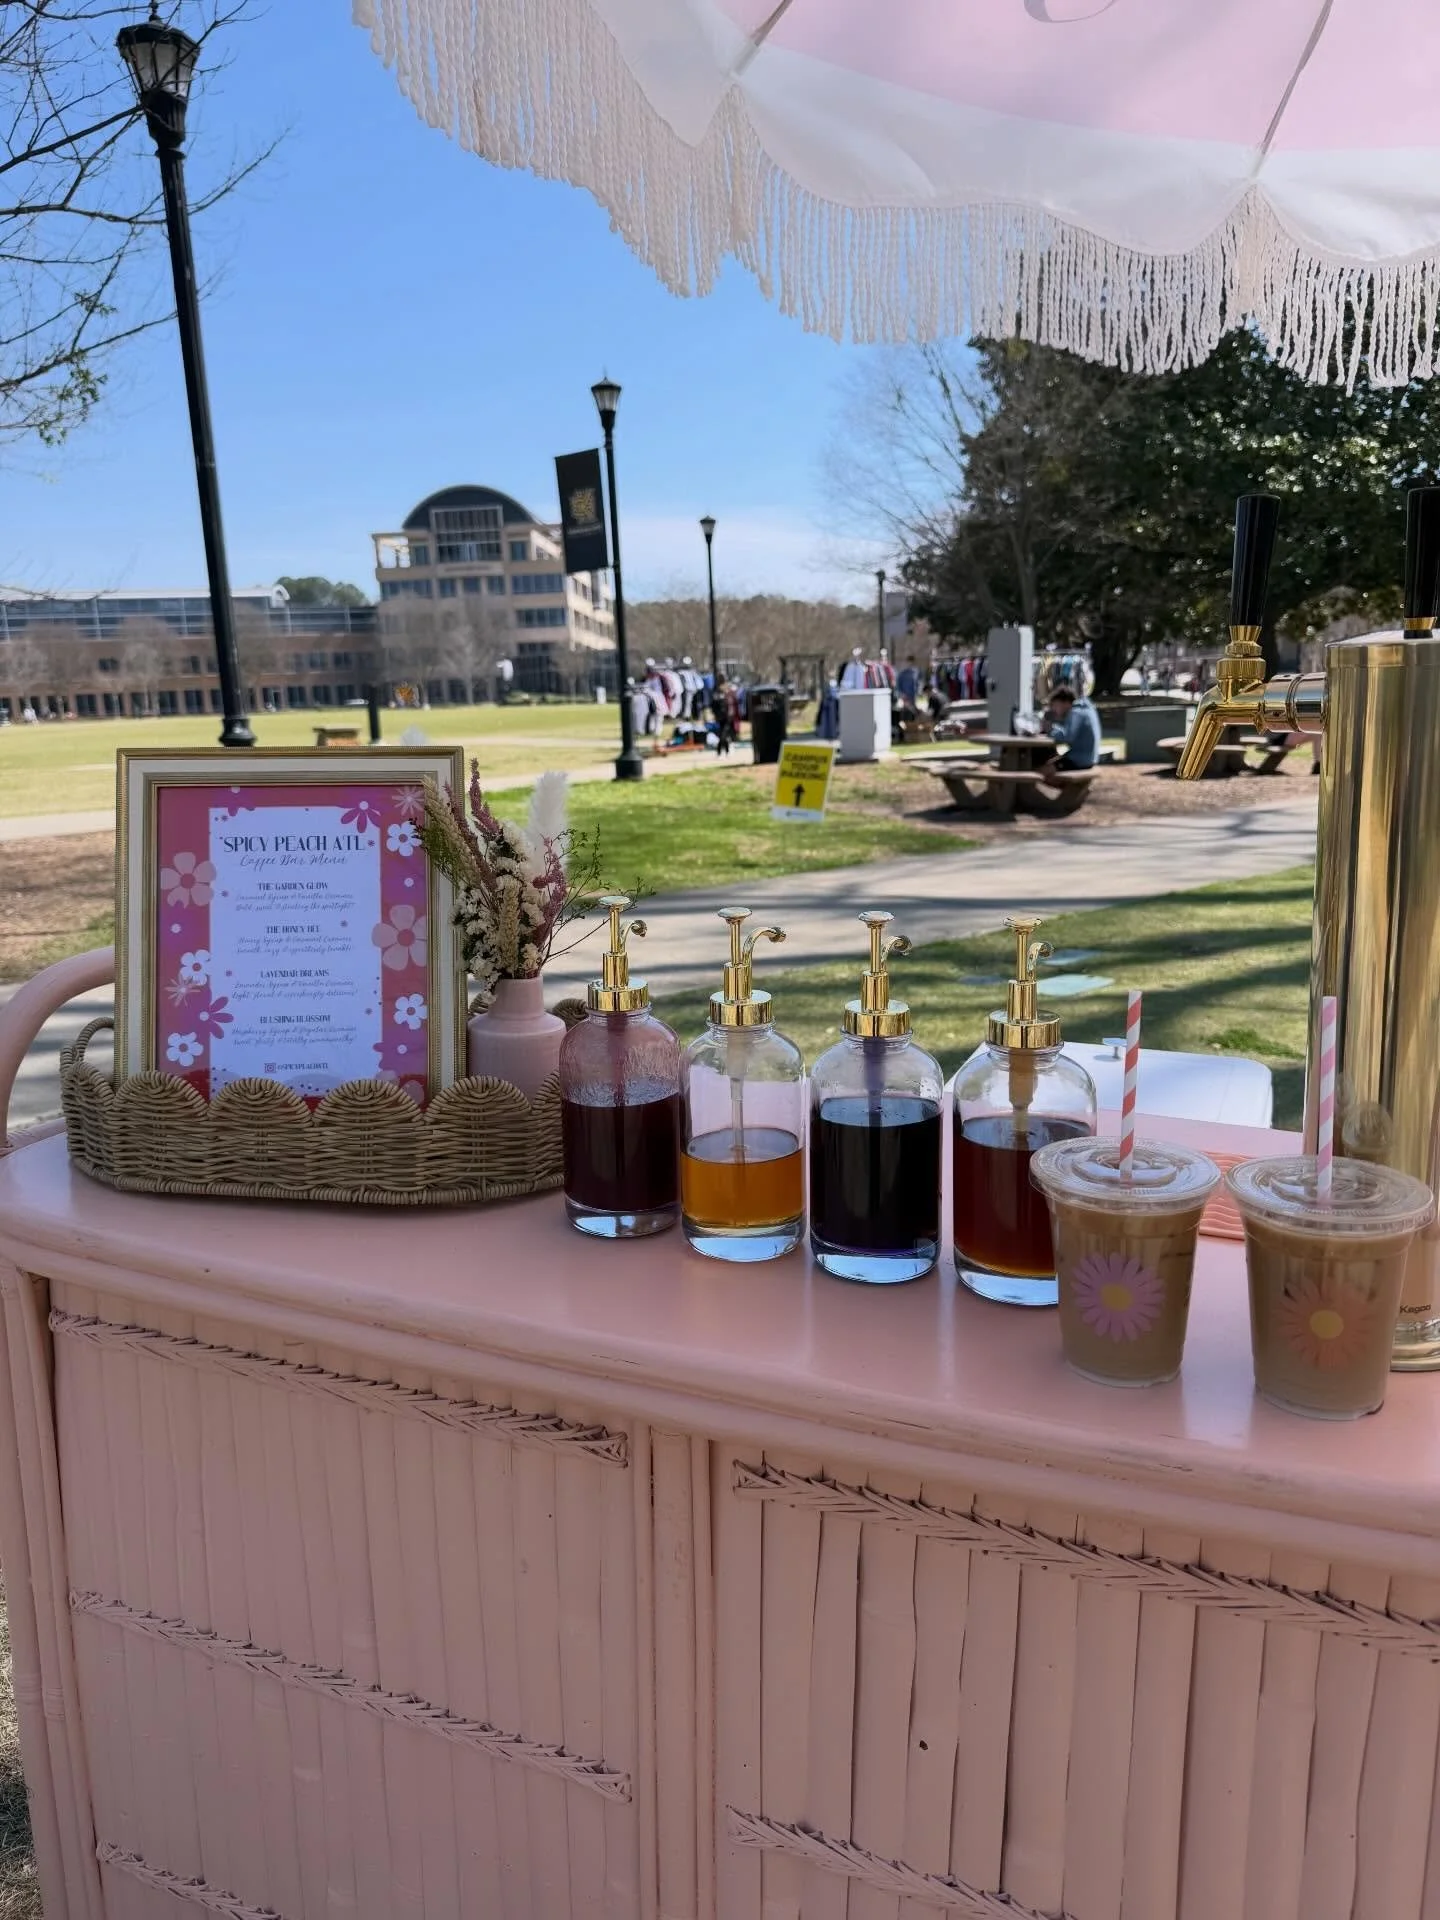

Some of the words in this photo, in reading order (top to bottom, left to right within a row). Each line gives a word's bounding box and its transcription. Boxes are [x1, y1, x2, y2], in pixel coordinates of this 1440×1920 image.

[224, 836, 268, 852] SPICY
[275, 835, 326, 851] PEACH
[333, 835, 365, 850] ATL
[240, 855, 276, 871] Coffee
[280, 854, 305, 866] Bar
[310, 853, 347, 866] Menu
[258, 882, 273, 891] THE
[275, 882, 305, 890] GARDEN
[306, 881, 328, 890] GLOW
[267, 925, 281, 934] THE
[282, 925, 305, 934] HONEY
[307, 925, 320, 933] BEE
[300, 969, 329, 978] DREAMS
[260, 1015, 294, 1024] BLUSHING
[296, 1014, 331, 1023] BLOSSOM
